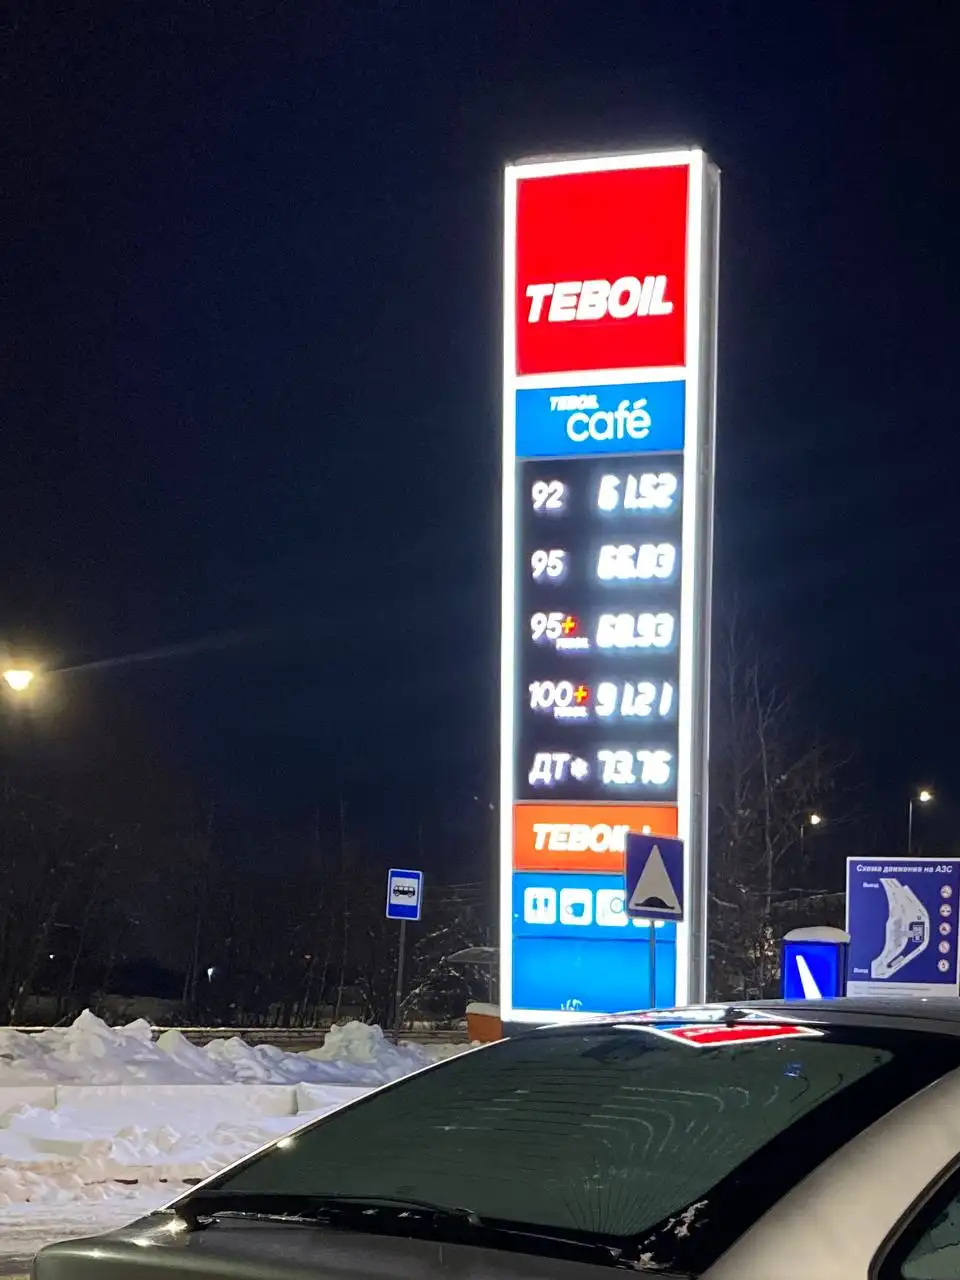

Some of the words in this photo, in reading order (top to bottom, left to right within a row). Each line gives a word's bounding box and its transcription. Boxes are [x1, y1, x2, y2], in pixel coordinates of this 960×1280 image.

[525, 275, 674, 323] TEBOIL
[566, 398, 652, 442] café
[531, 480, 565, 511] 92
[531, 550, 566, 579] 95
[528, 752, 572, 785] ДТ
[935, 865, 953, 873] АЗС
